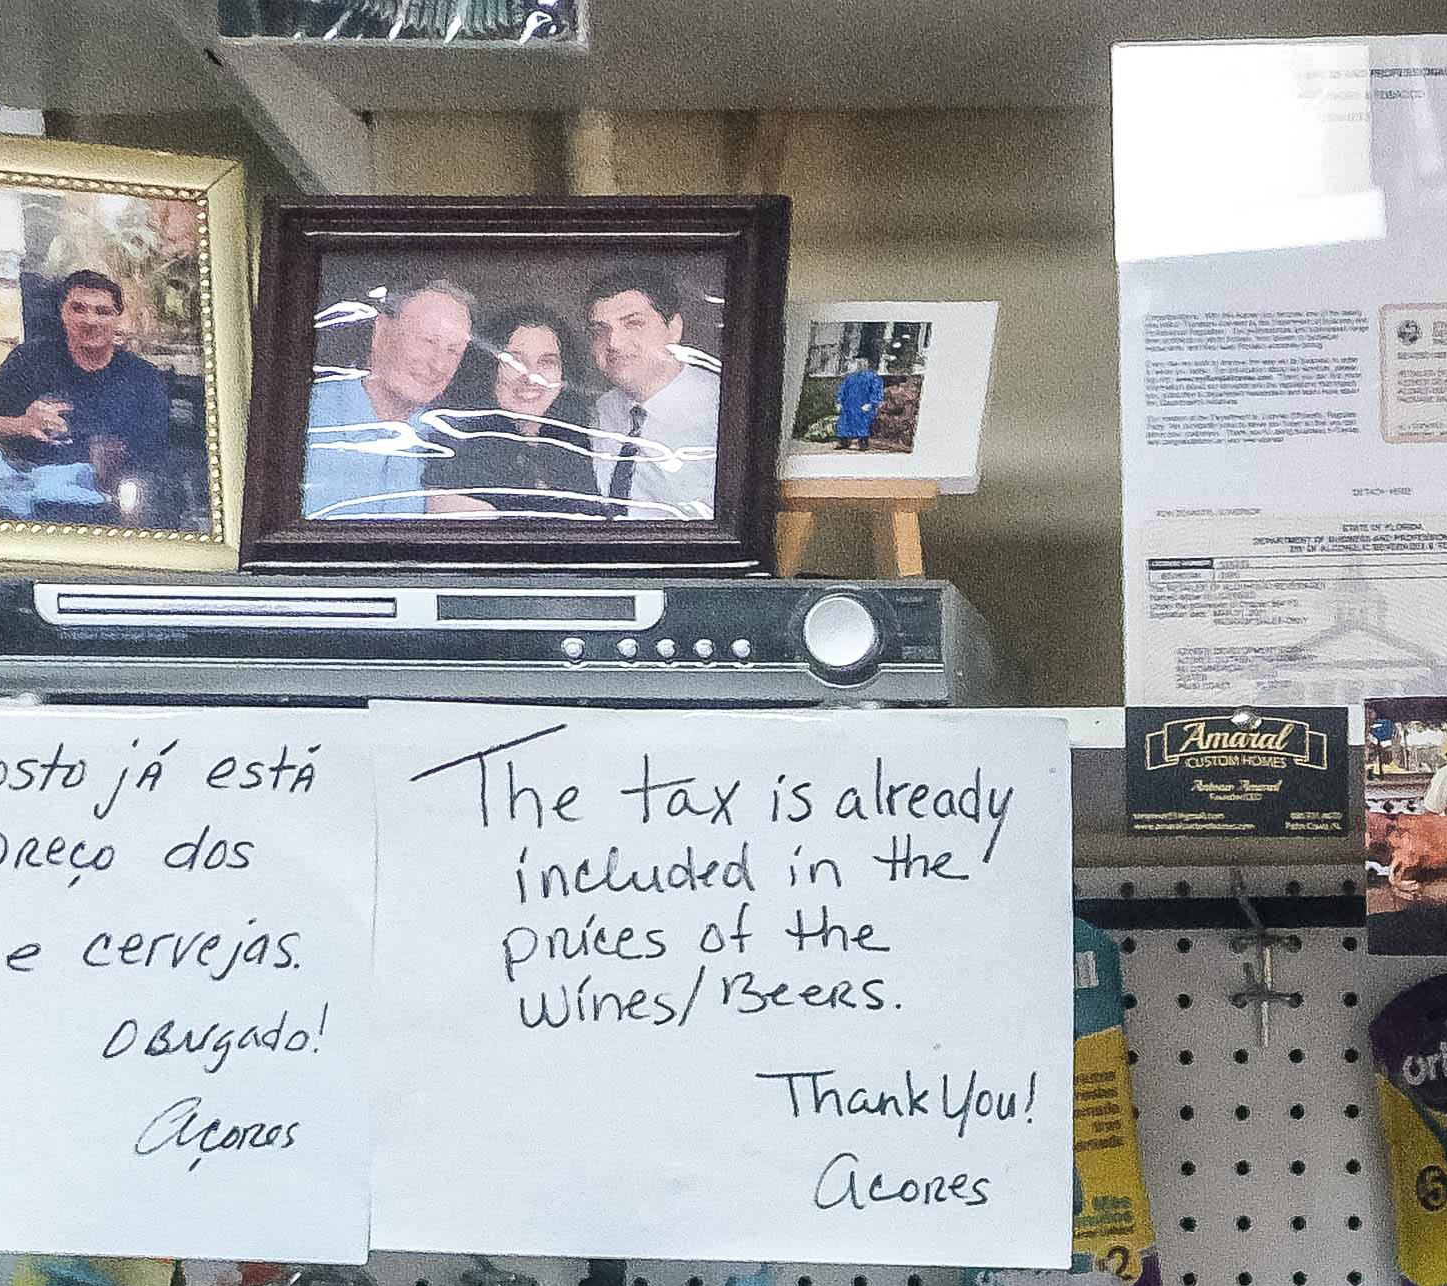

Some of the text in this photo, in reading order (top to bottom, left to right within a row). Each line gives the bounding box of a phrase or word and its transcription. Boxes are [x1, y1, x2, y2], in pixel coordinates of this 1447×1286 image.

[1180, 721, 1295, 752] Amaral
[410, 724, 1015, 863] The tax is already
[163, 825, 254, 872] dos
[515, 835, 970, 904] included in the
[5, 941, 42, 973] e
[82, 918, 302, 981] cervejas.
[502, 901, 891, 982] prices of the
